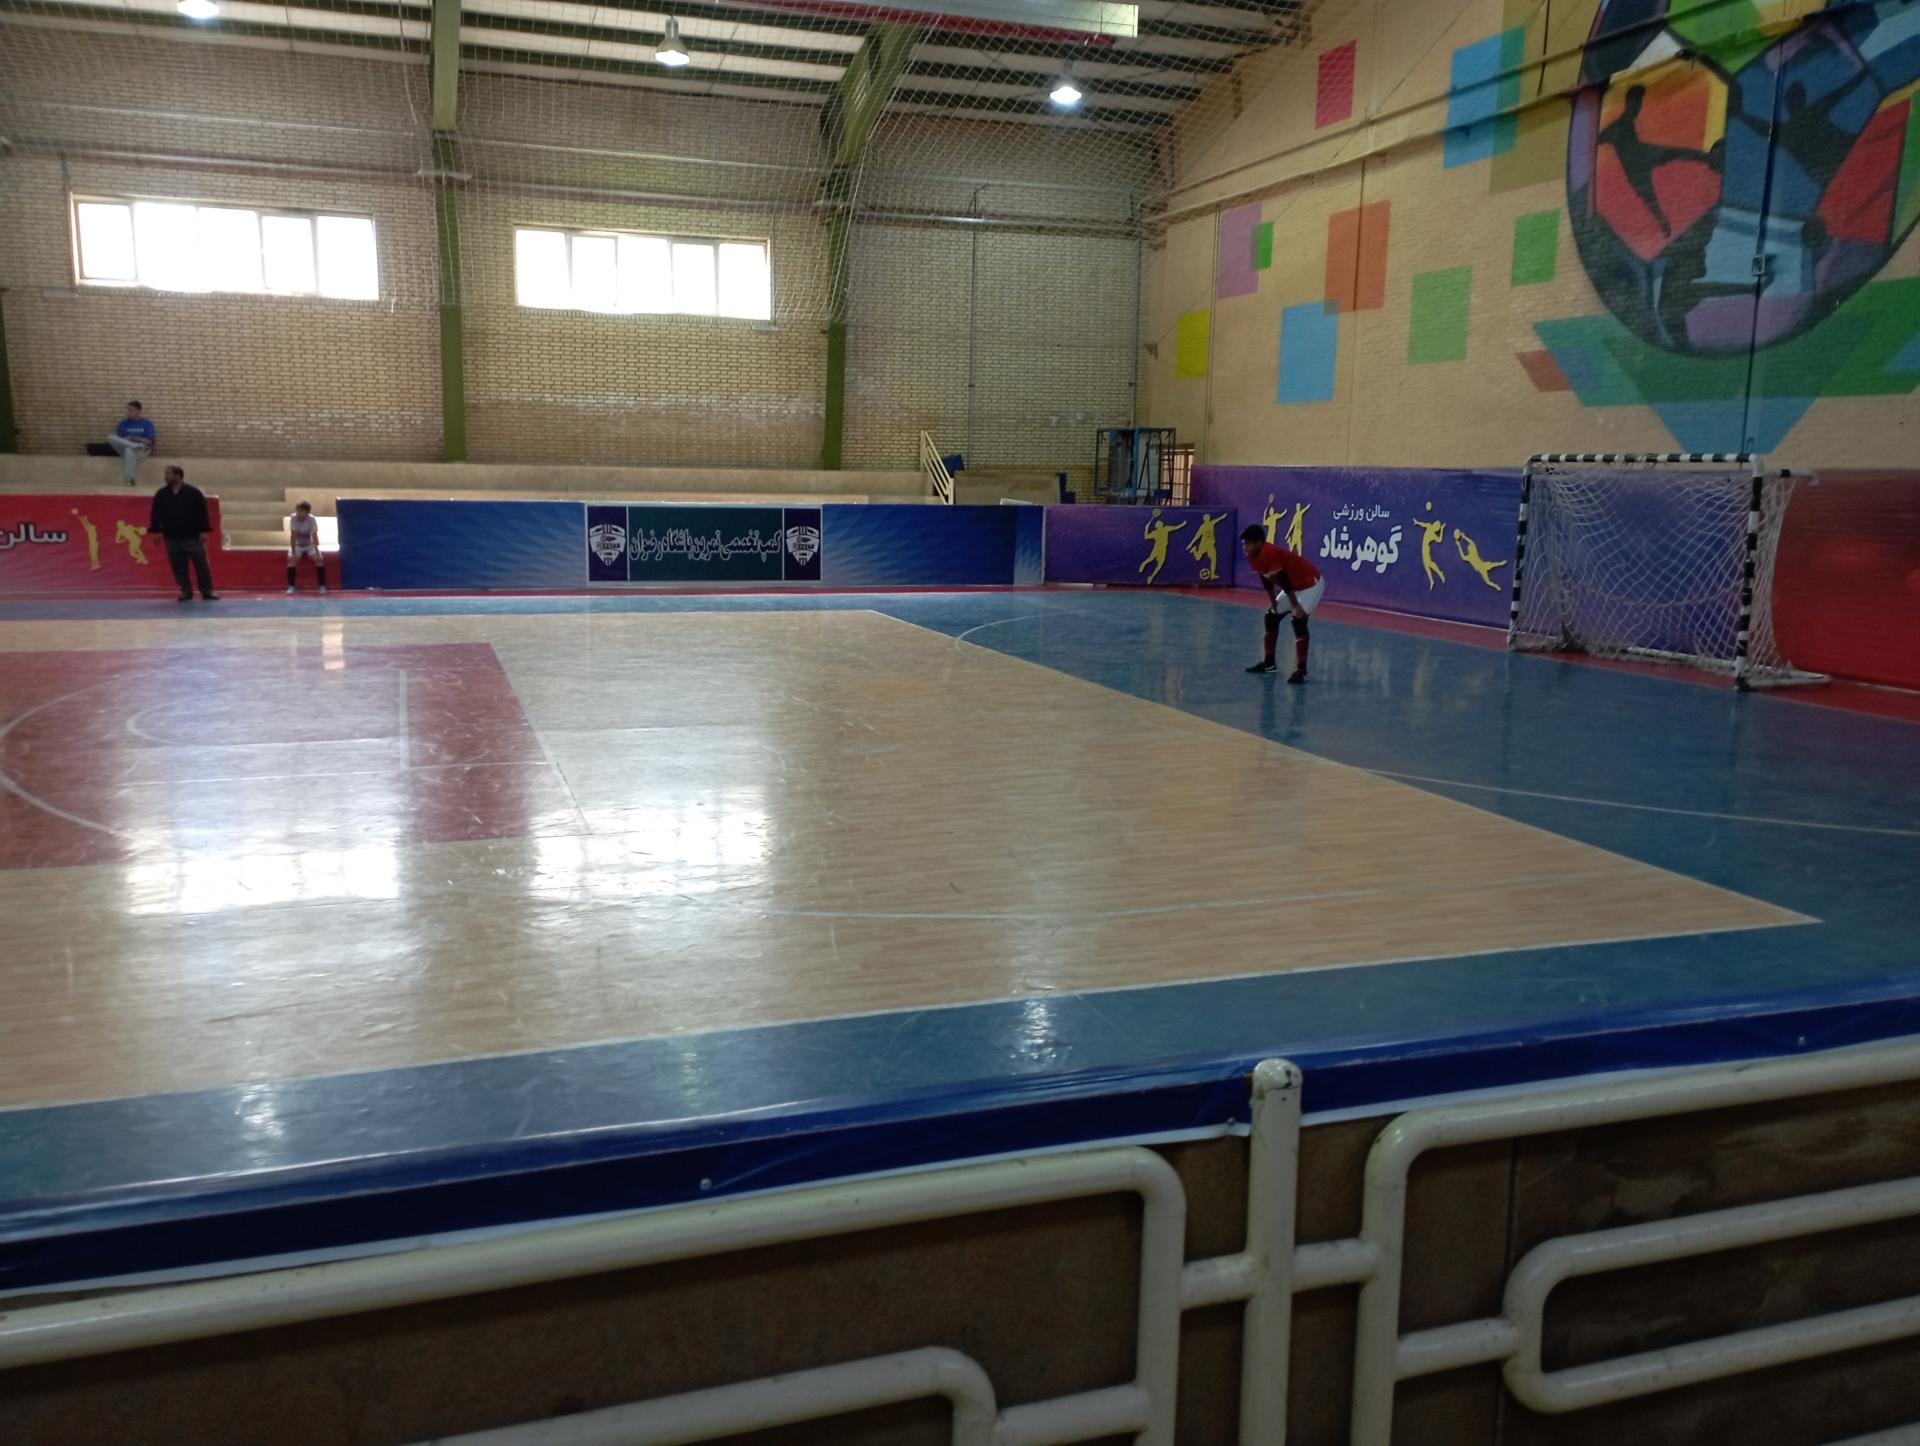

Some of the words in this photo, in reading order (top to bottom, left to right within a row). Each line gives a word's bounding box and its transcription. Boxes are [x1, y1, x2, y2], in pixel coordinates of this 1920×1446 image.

[1333, 504, 1365, 521] ورزشی
[1366, 504, 1390, 521] سالن
[629, 527, 664, 561] رضوان
[662, 528, 693, 560] باشگاه
[1320, 525, 1402, 573] گوهرشاد
